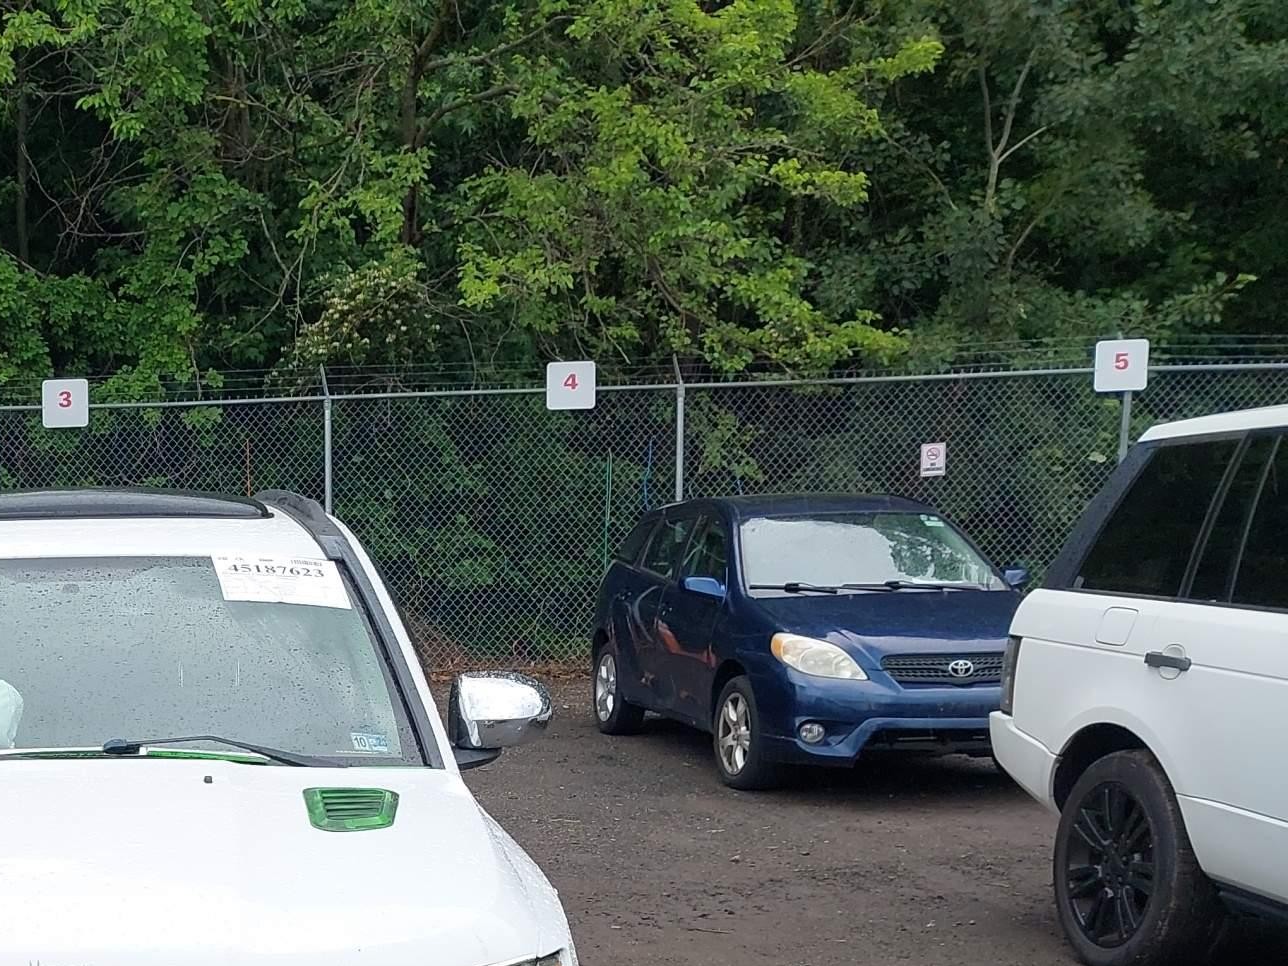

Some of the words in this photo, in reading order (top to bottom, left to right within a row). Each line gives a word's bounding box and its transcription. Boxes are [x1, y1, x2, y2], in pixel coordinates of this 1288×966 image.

[1114, 352, 1129, 370] 5
[563, 373, 579, 390] 4
[58, 391, 72, 408] 3
[228, 563, 325, 578] 45187623
[354, 736, 367, 748] 10
